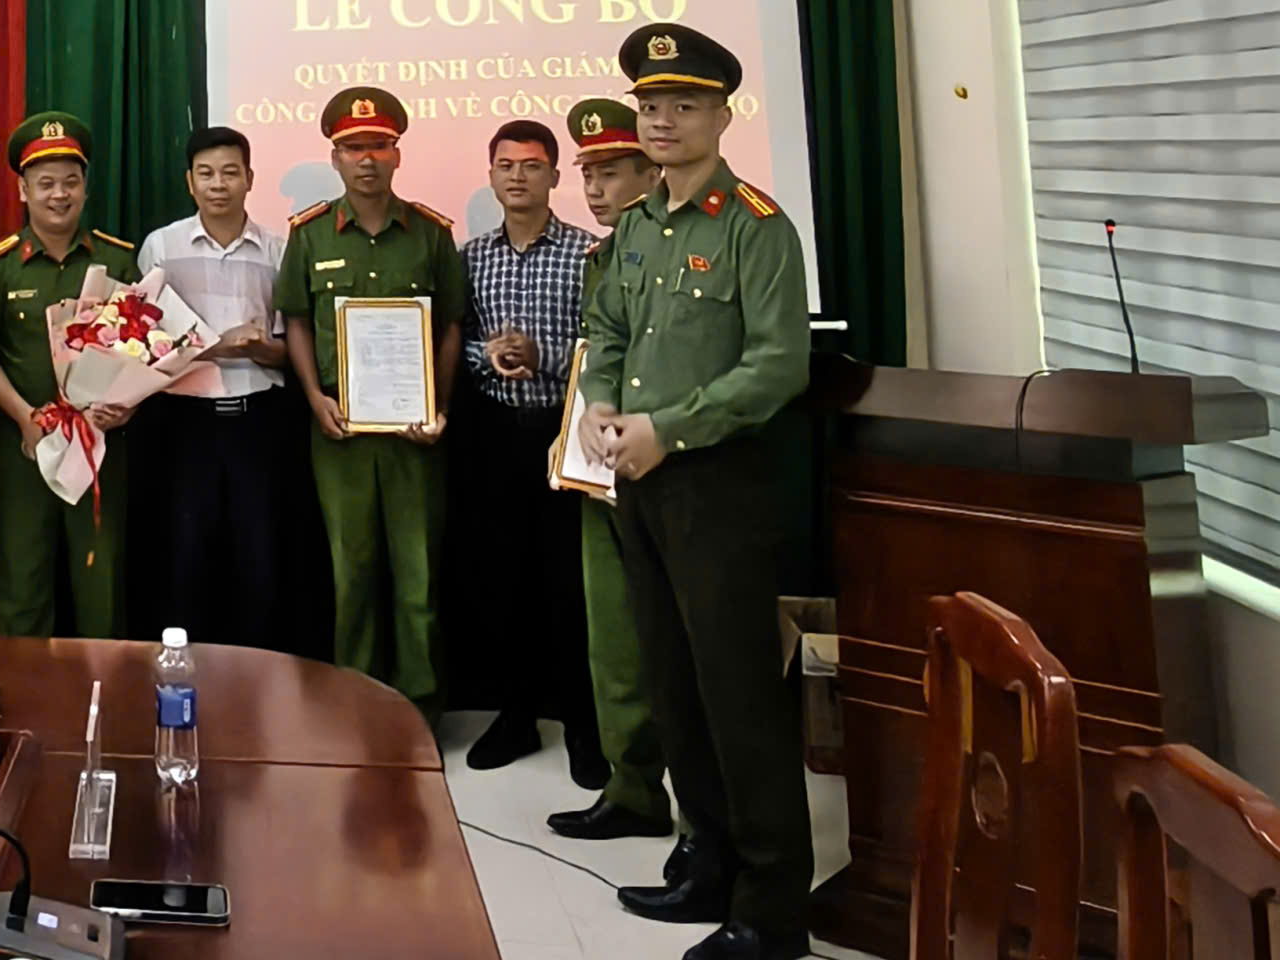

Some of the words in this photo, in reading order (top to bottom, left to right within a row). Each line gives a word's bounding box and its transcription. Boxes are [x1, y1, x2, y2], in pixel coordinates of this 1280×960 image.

[398, 58, 467, 87] ĐỊNH
[542, 51, 620, 79] GIÁM
[235, 97, 316, 125] CÔNG
[491, 89, 570, 118] CÔNG
